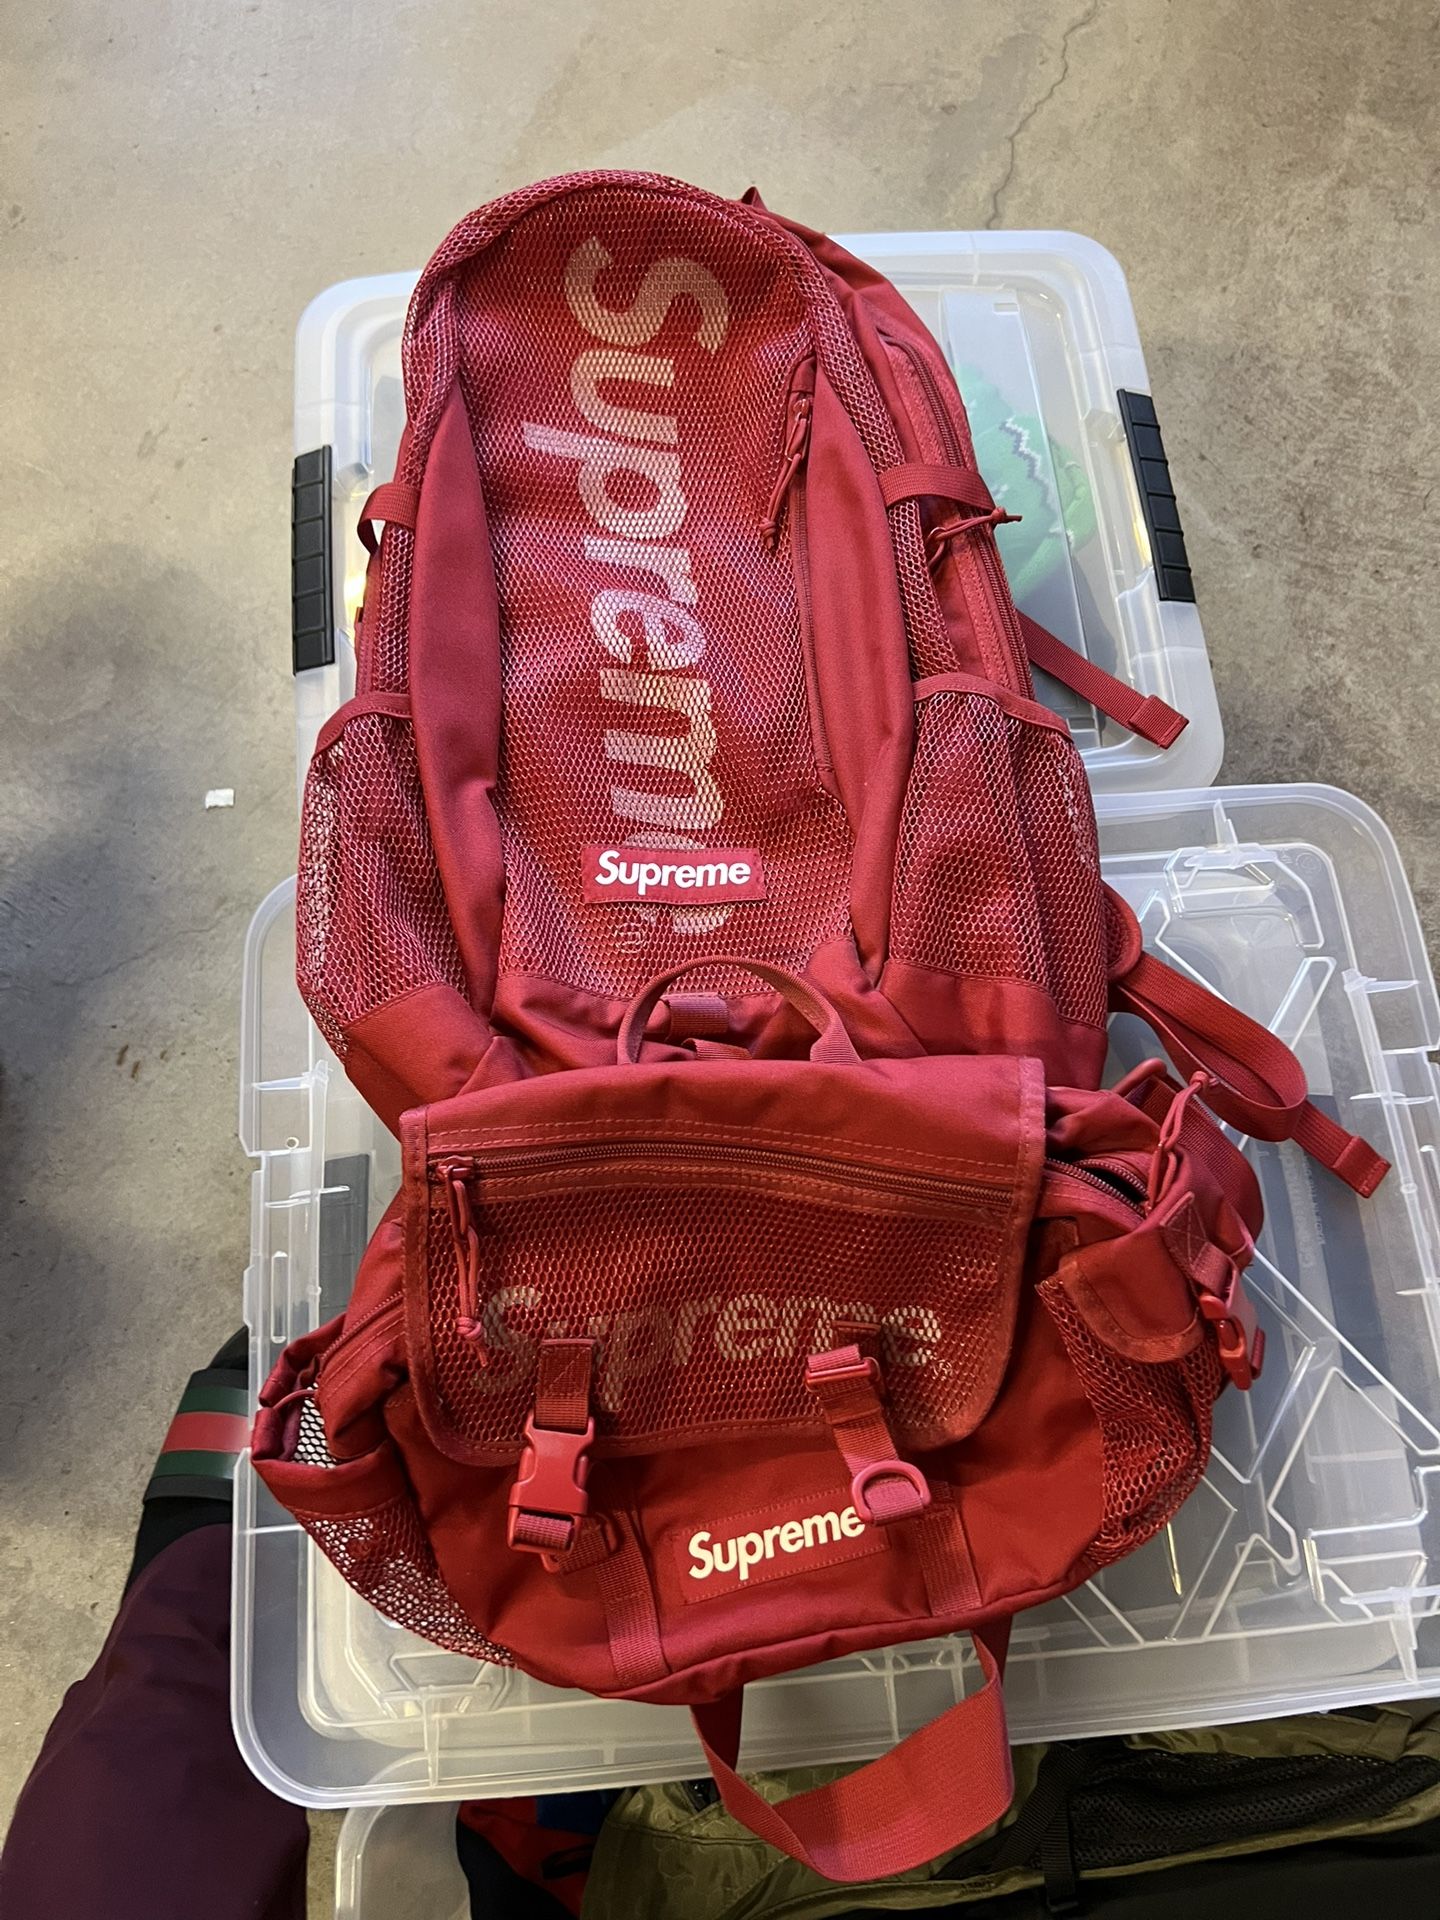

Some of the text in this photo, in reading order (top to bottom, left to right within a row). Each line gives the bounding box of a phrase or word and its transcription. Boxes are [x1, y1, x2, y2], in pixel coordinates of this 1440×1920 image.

[595, 849, 751, 896] Supreme
[469, 1286, 942, 1413] Spreme
[688, 1505, 865, 1581] Supreme
